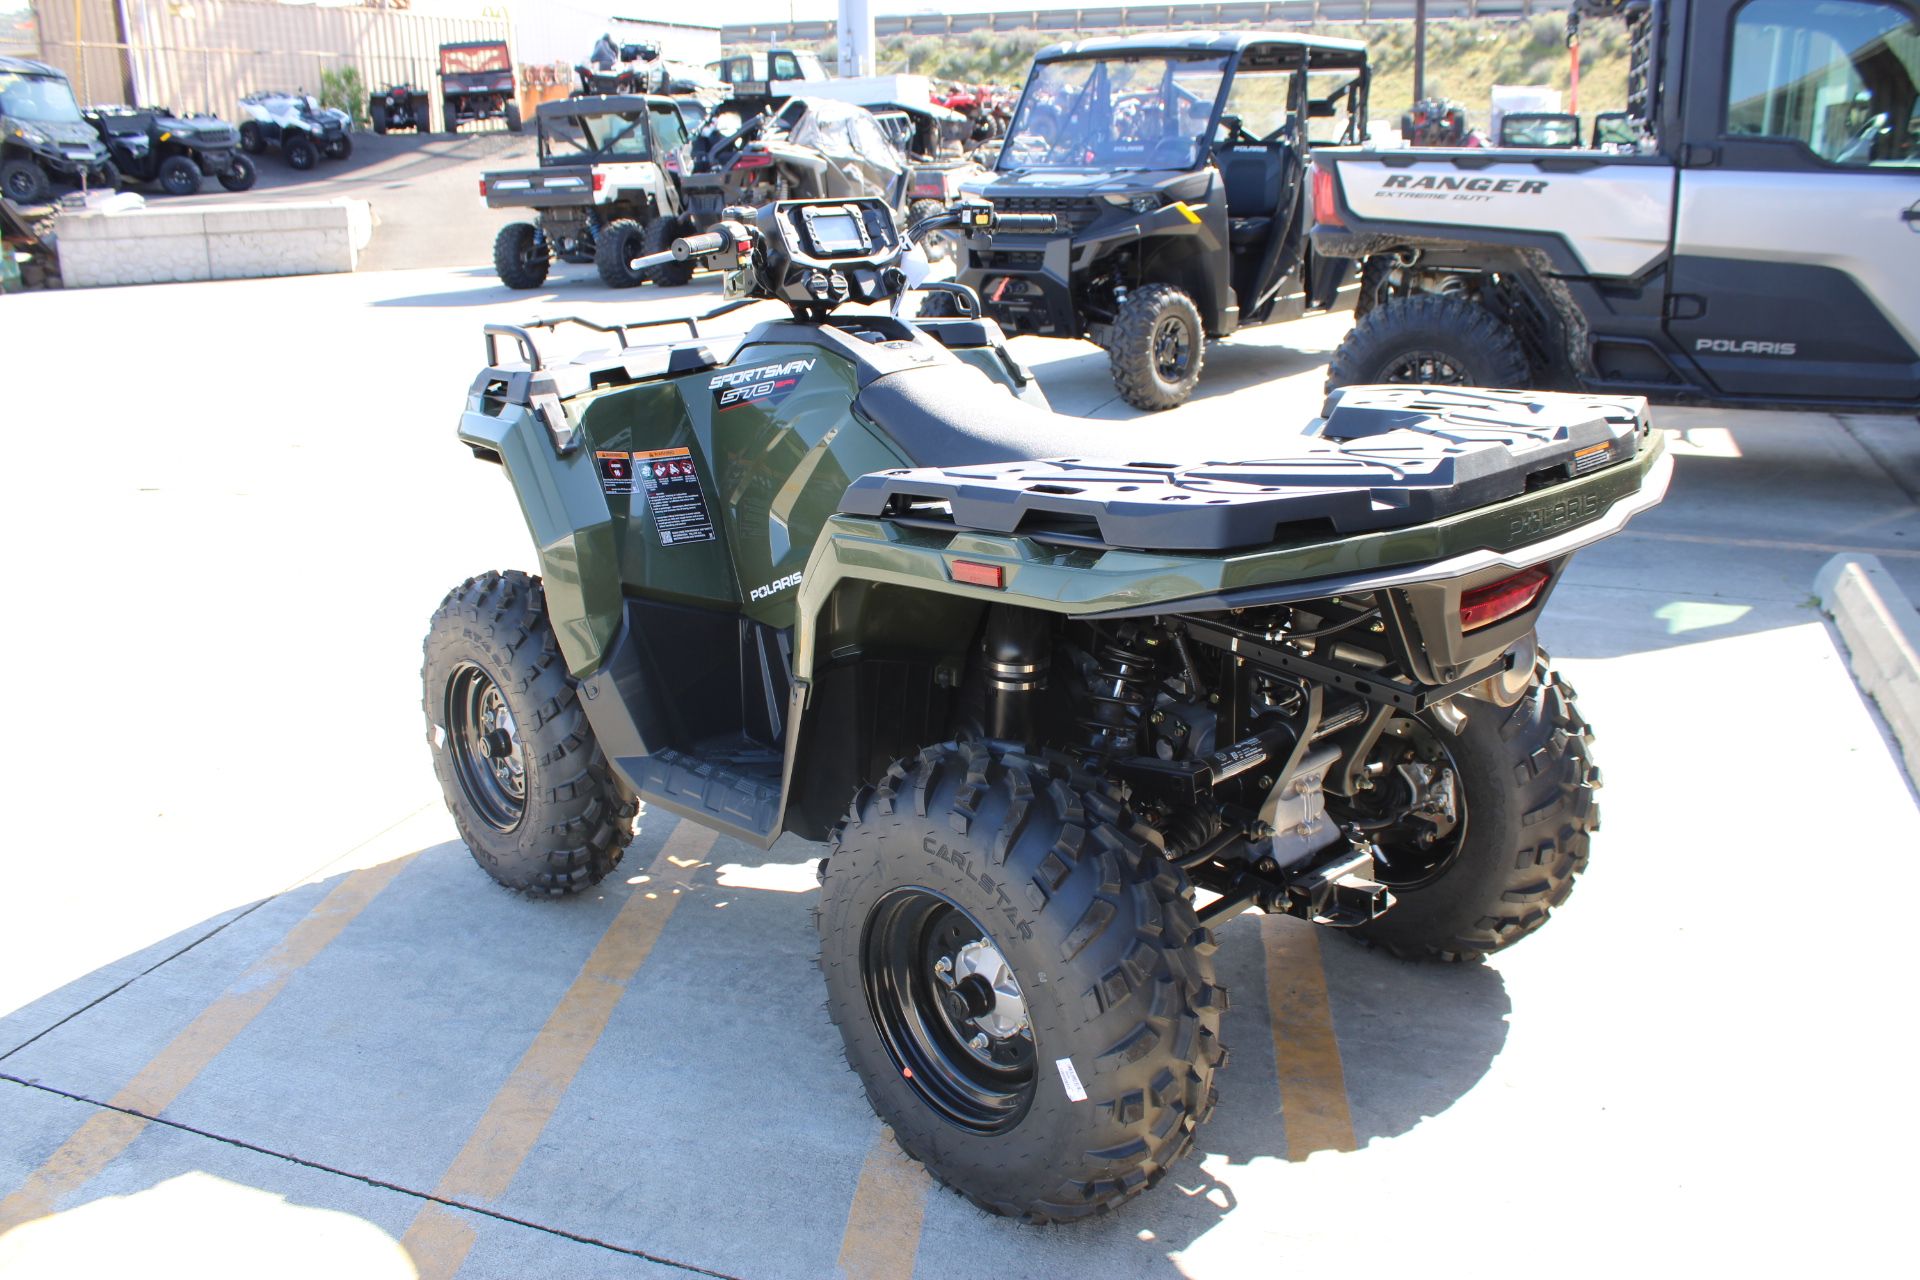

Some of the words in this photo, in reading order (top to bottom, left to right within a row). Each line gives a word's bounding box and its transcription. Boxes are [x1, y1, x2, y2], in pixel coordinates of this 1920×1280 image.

[1374, 190, 1448, 201] EXTREME
[1453, 193, 1495, 202] DUTY
[1382, 174, 1549, 194] RANGER
[1695, 338, 1797, 356] POLARIS
[708, 358, 817, 390] SPORTSMAN
[720, 380, 776, 405] 570
[1508, 494, 1599, 542] POLARIS
[750, 571, 803, 602] POLARIS
[922, 836, 1034, 942] CARLSTAR
